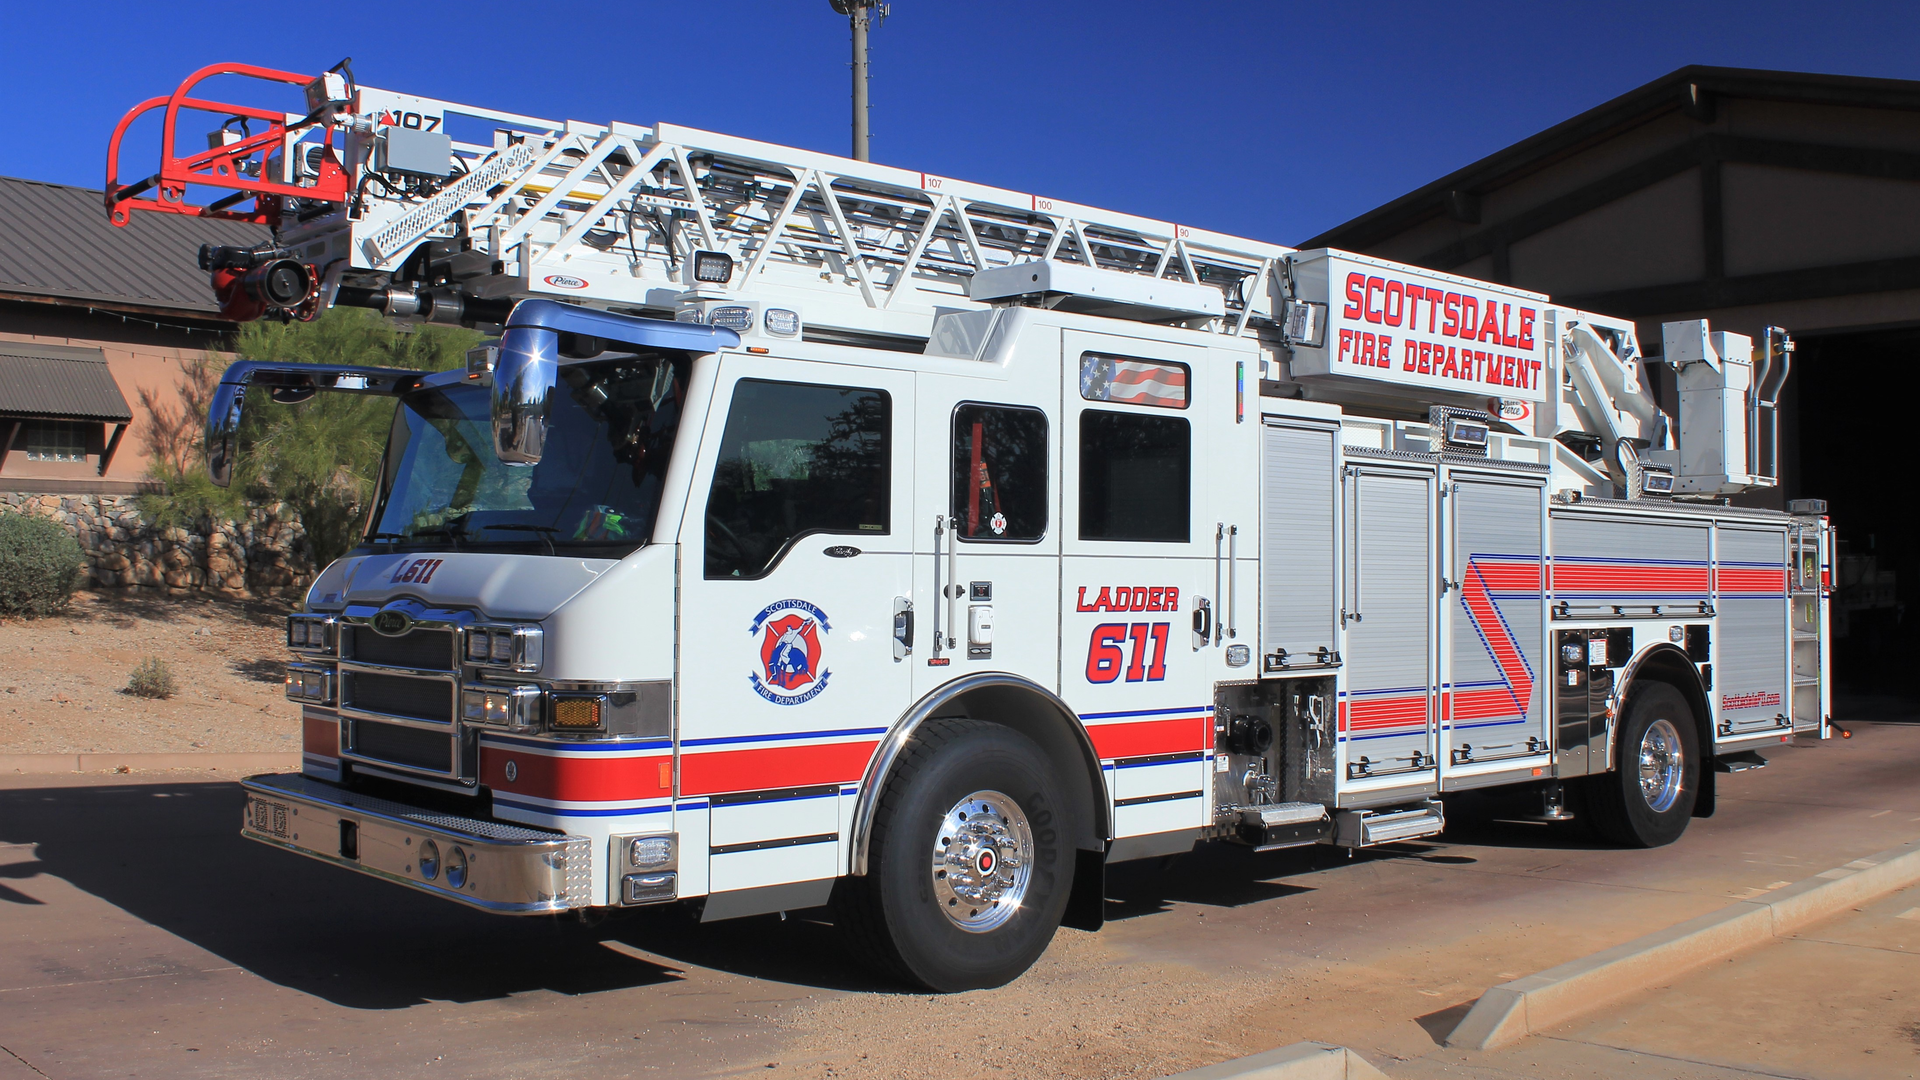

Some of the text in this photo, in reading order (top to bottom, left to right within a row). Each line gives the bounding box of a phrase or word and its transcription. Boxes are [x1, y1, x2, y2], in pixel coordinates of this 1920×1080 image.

[393, 110, 441, 132] 107
[928, 178, 942, 189] 107
[1038, 200, 1052, 210] 100
[1180, 228, 1189, 238] 90
[553, 276, 580, 287] Pierce
[1343, 271, 1536, 351] SCOTTSDALE
[1338, 328, 1542, 390] FIRE DEPARTMENT
[1497, 402, 1521, 416] Pierce
[390, 559, 444, 584] L611
[765, 599, 817, 616] SCOTTSDALE
[1076, 586, 1179, 612] LADDER
[1085, 622, 1170, 684] 611
[757, 681, 825, 705] FIRE DEPARTMENT
